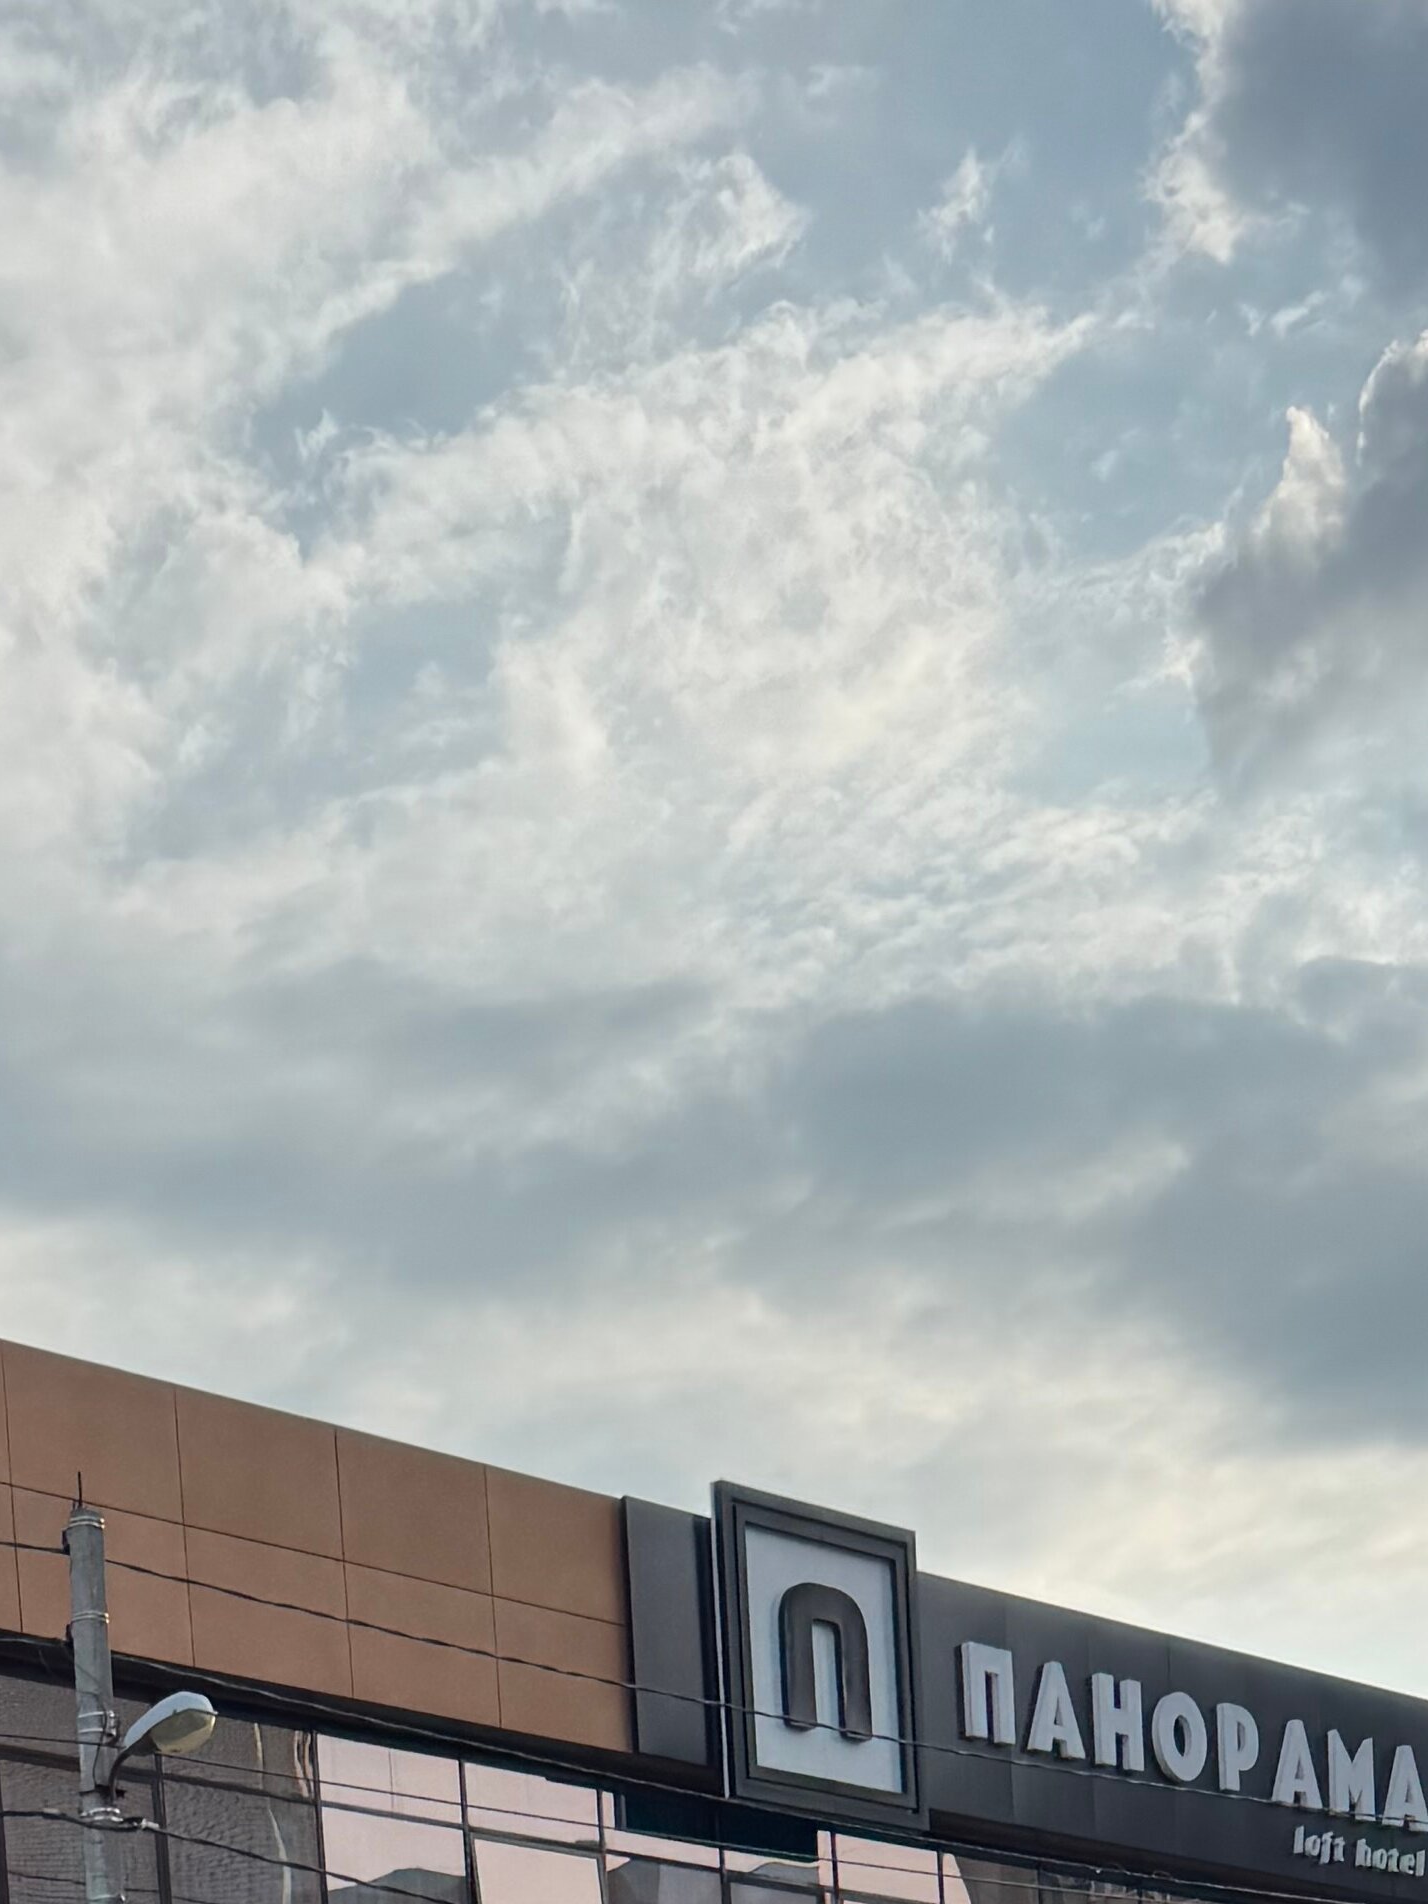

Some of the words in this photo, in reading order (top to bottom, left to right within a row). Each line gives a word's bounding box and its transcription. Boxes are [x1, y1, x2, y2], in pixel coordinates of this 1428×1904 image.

[779, 1580, 873, 1742] П
[1292, 1824, 1346, 1864] loft
[1354, 1838, 1426, 1877] hotel
